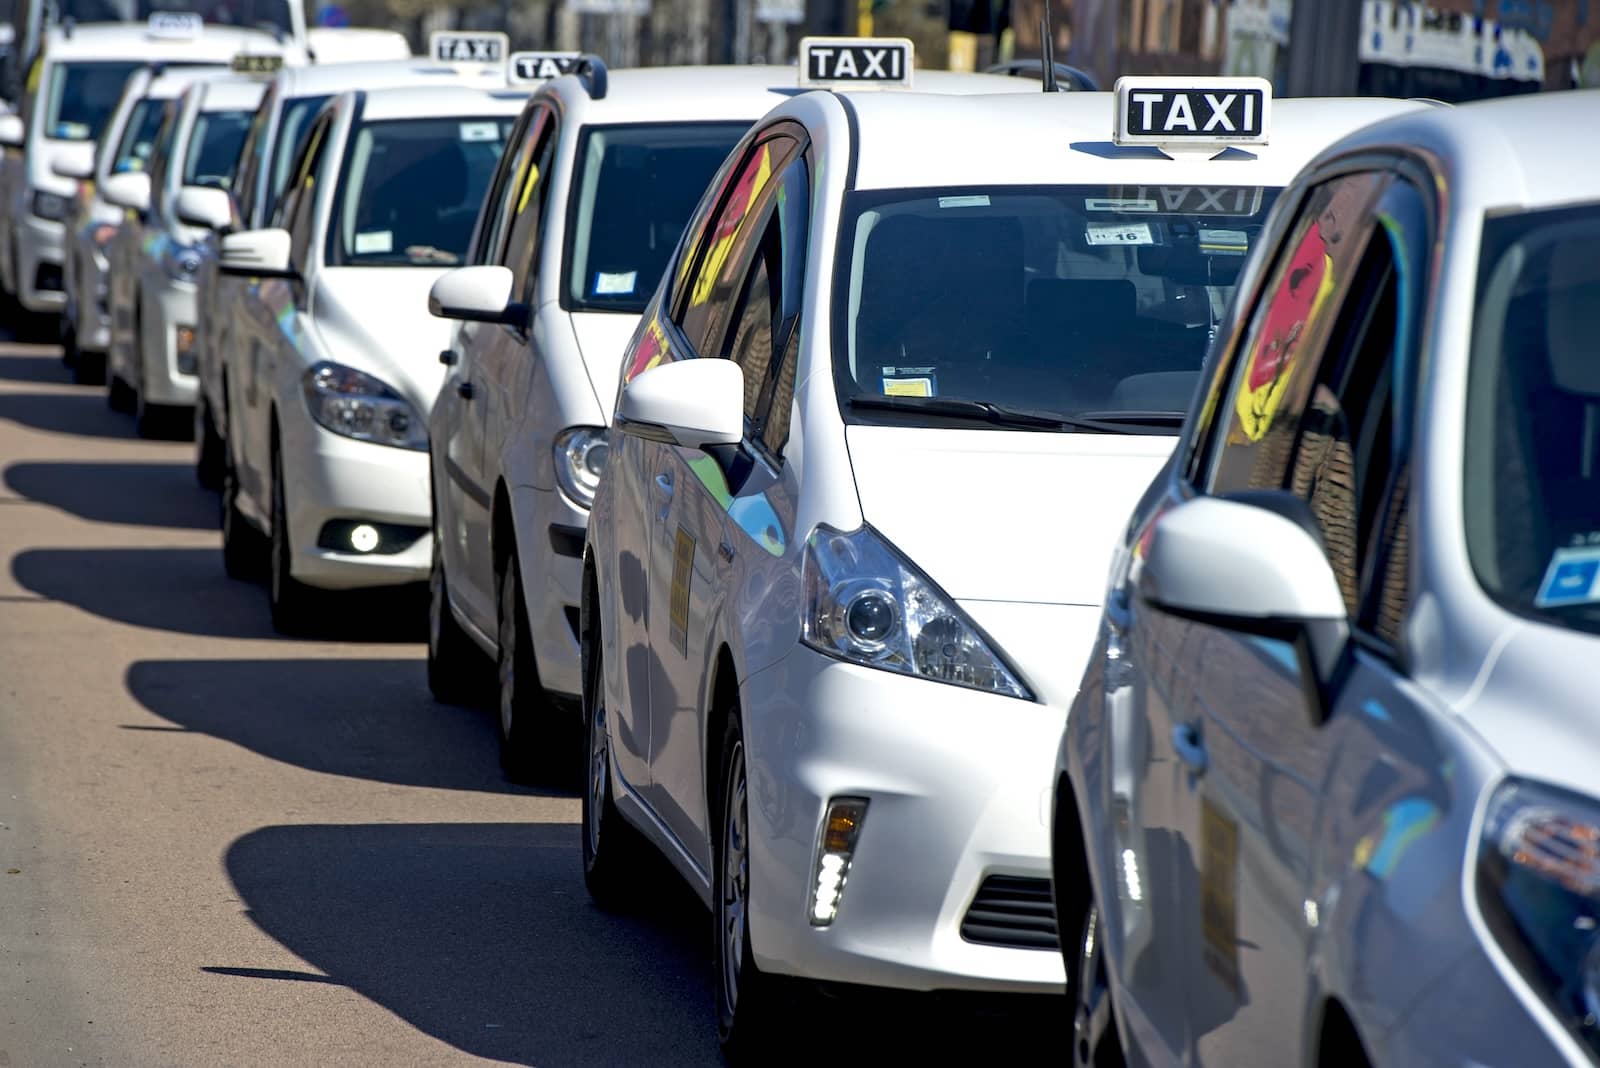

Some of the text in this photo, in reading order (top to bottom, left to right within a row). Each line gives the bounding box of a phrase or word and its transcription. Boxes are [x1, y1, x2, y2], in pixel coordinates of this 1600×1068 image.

[438, 40, 499, 60] TAXI
[517, 59, 569, 78] TA
[810, 49, 899, 77] TAXI
[1133, 94, 1254, 131] TAXI
